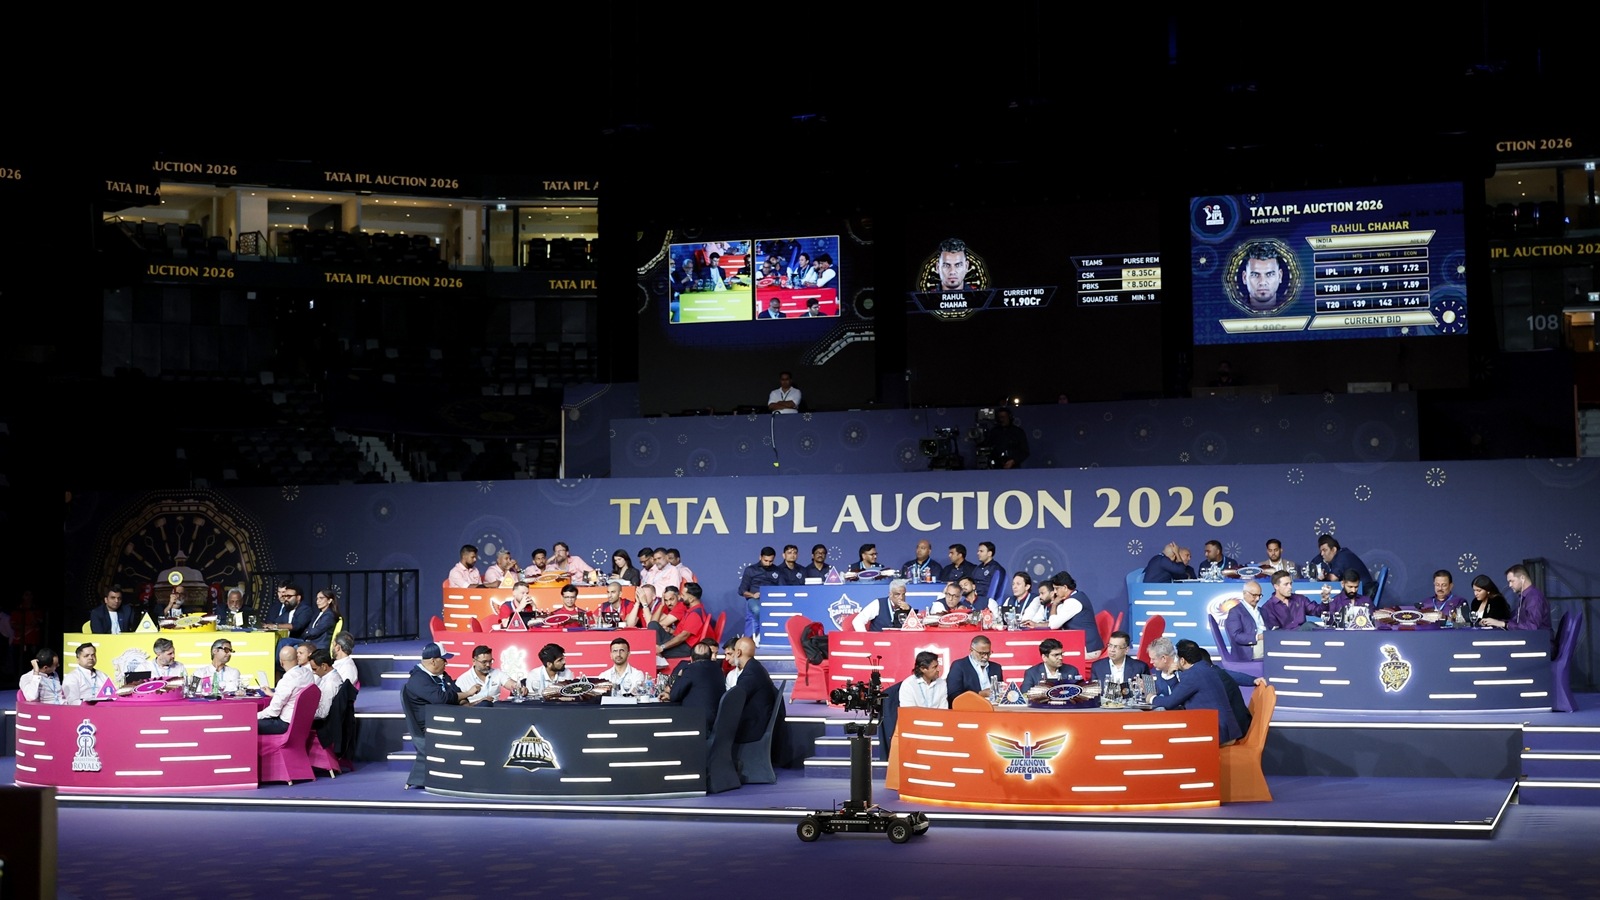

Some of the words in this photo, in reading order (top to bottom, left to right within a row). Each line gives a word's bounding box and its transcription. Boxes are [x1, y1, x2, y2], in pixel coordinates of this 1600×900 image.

[1540, 138, 1573, 150] 2026
[153, 161, 202, 173] UCTION
[206, 164, 237, 176] 2026
[324, 171, 352, 183] TATA
[355, 173, 372, 184] IPL
[375, 175, 427, 187] AUCTION
[430, 178, 459, 189] 2026
[542, 180, 570, 191] TATA
[573, 181, 590, 191] IPL
[106, 180, 132, 194] TATA
[135, 184, 151, 196] IPL
[1250, 206, 1280, 217] TATA
[1282, 205, 1301, 215] IPL
[1303, 201, 1353, 214] AUCTION
[1356, 200, 1383, 211] 2026
[1331, 223, 1365, 233] RAHUL
[1368, 221, 1409, 231] CHAHAR
[1490, 247, 1510, 258] IPL
[1513, 244, 1574, 258] AUCTION
[148, 265, 199, 277] UCTION
[202, 267, 234, 279] 2026
[1403, 264, 1419, 272] 7.72
[324, 272, 353, 284] TATA
[356, 273, 374, 285] IPL
[376, 275, 430, 287] AUCTION
[433, 277, 463, 289] 2026
[549, 279, 577, 290] TATA
[580, 279, 597, 290] IPL
[1356, 283, 1361, 291] 6
[1382, 282, 1388, 290] 7
[942, 293, 965, 301] RAHUL
[1326, 301, 1340, 309] T20
[1352, 300, 1366, 308] 139
[1403, 297, 1420, 305] 7.61
[1344, 316, 1385, 325] CURRENT
[1387, 315, 1401, 323] BID
[1526, 314, 1558, 331] 108
[610, 497, 730, 535] TATA
[745, 495, 818, 534] IPL
[831, 489, 1072, 533] AUCTION
[1093, 486, 1235, 528] 2026
[508, 741, 553, 761] TITANS
[1005, 766, 1026, 774] SUPER
